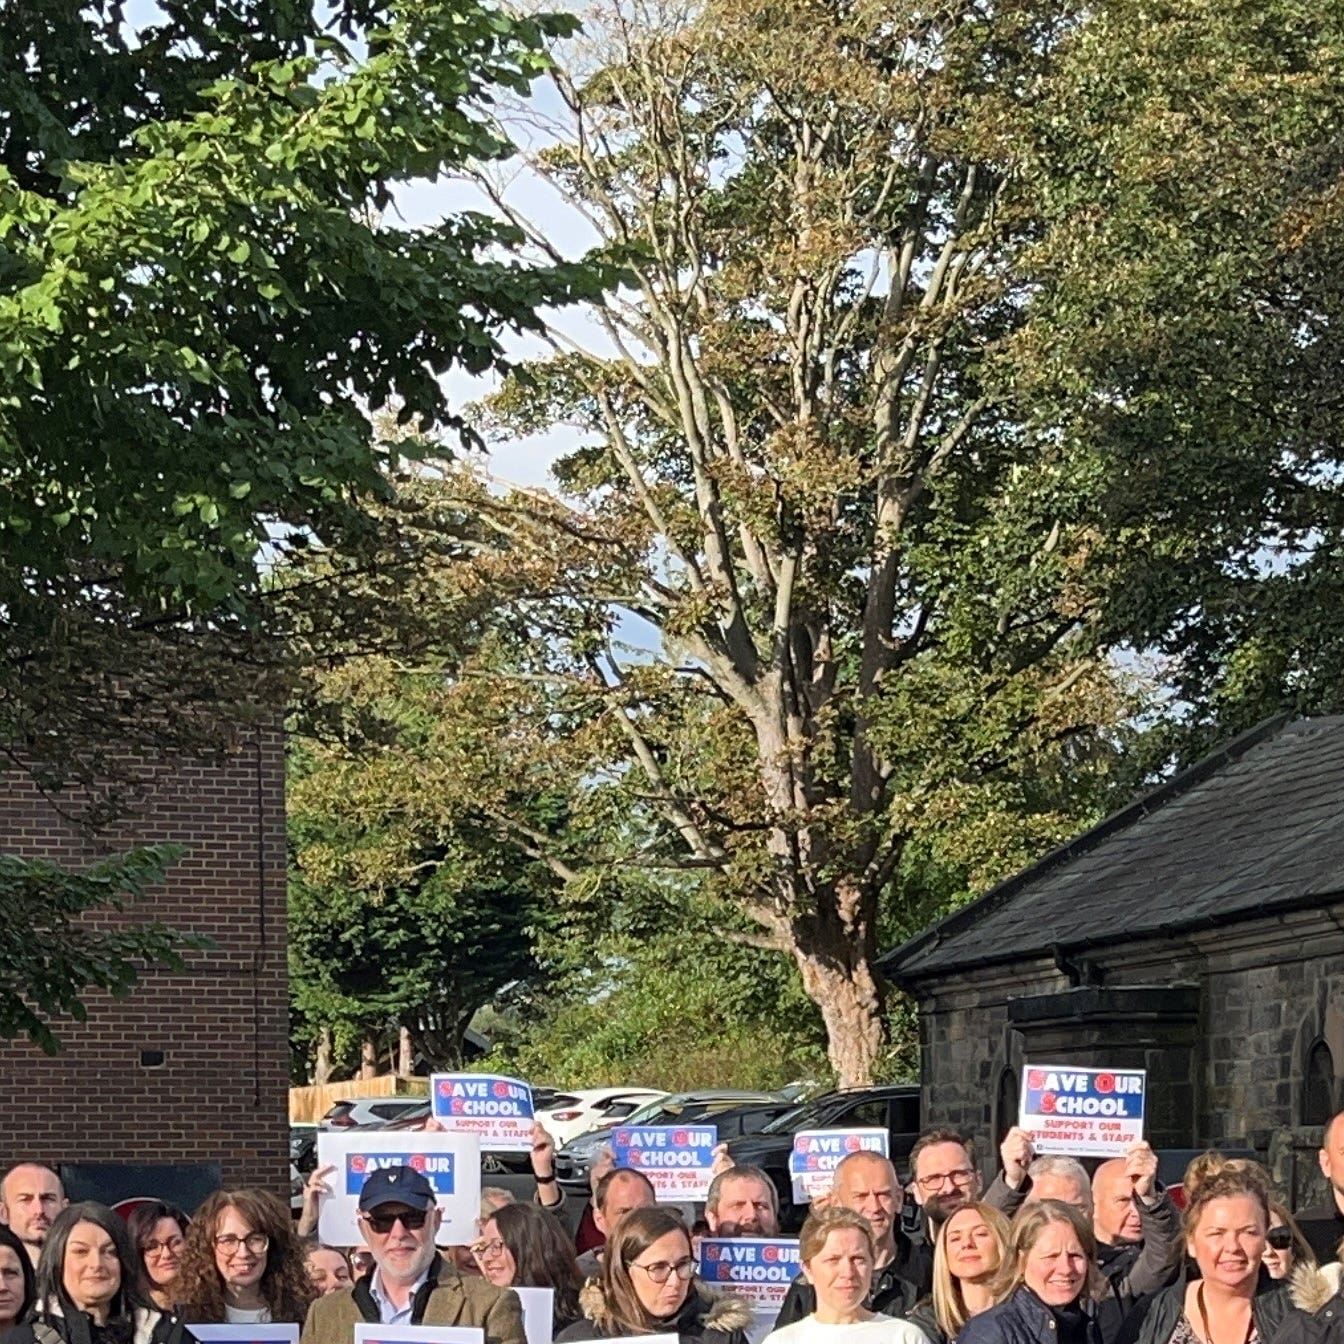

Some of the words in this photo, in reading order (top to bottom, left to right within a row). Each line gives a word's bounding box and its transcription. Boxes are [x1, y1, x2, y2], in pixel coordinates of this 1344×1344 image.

[439, 1081, 488, 1098] SAVE
[493, 1082, 528, 1101] OUR
[1028, 1071, 1088, 1092] SAVE
[1094, 1073, 1142, 1094] OUR
[451, 1101, 520, 1116] SCHOOL
[1041, 1092, 1127, 1116] SCHOOL
[1044, 1120, 1094, 1129] SUPPORT
[1099, 1122, 1121, 1130] OUR
[617, 1129, 666, 1147] SAVE
[672, 1130, 711, 1147] OUR
[797, 1138, 840, 1153] SAVE
[845, 1136, 881, 1151] OUR
[409, 1155, 450, 1173] OUR
[628, 1148, 701, 1166] SCHOOL
[706, 1245, 755, 1262] SAVE
[717, 1263, 790, 1280] SCHOOL
